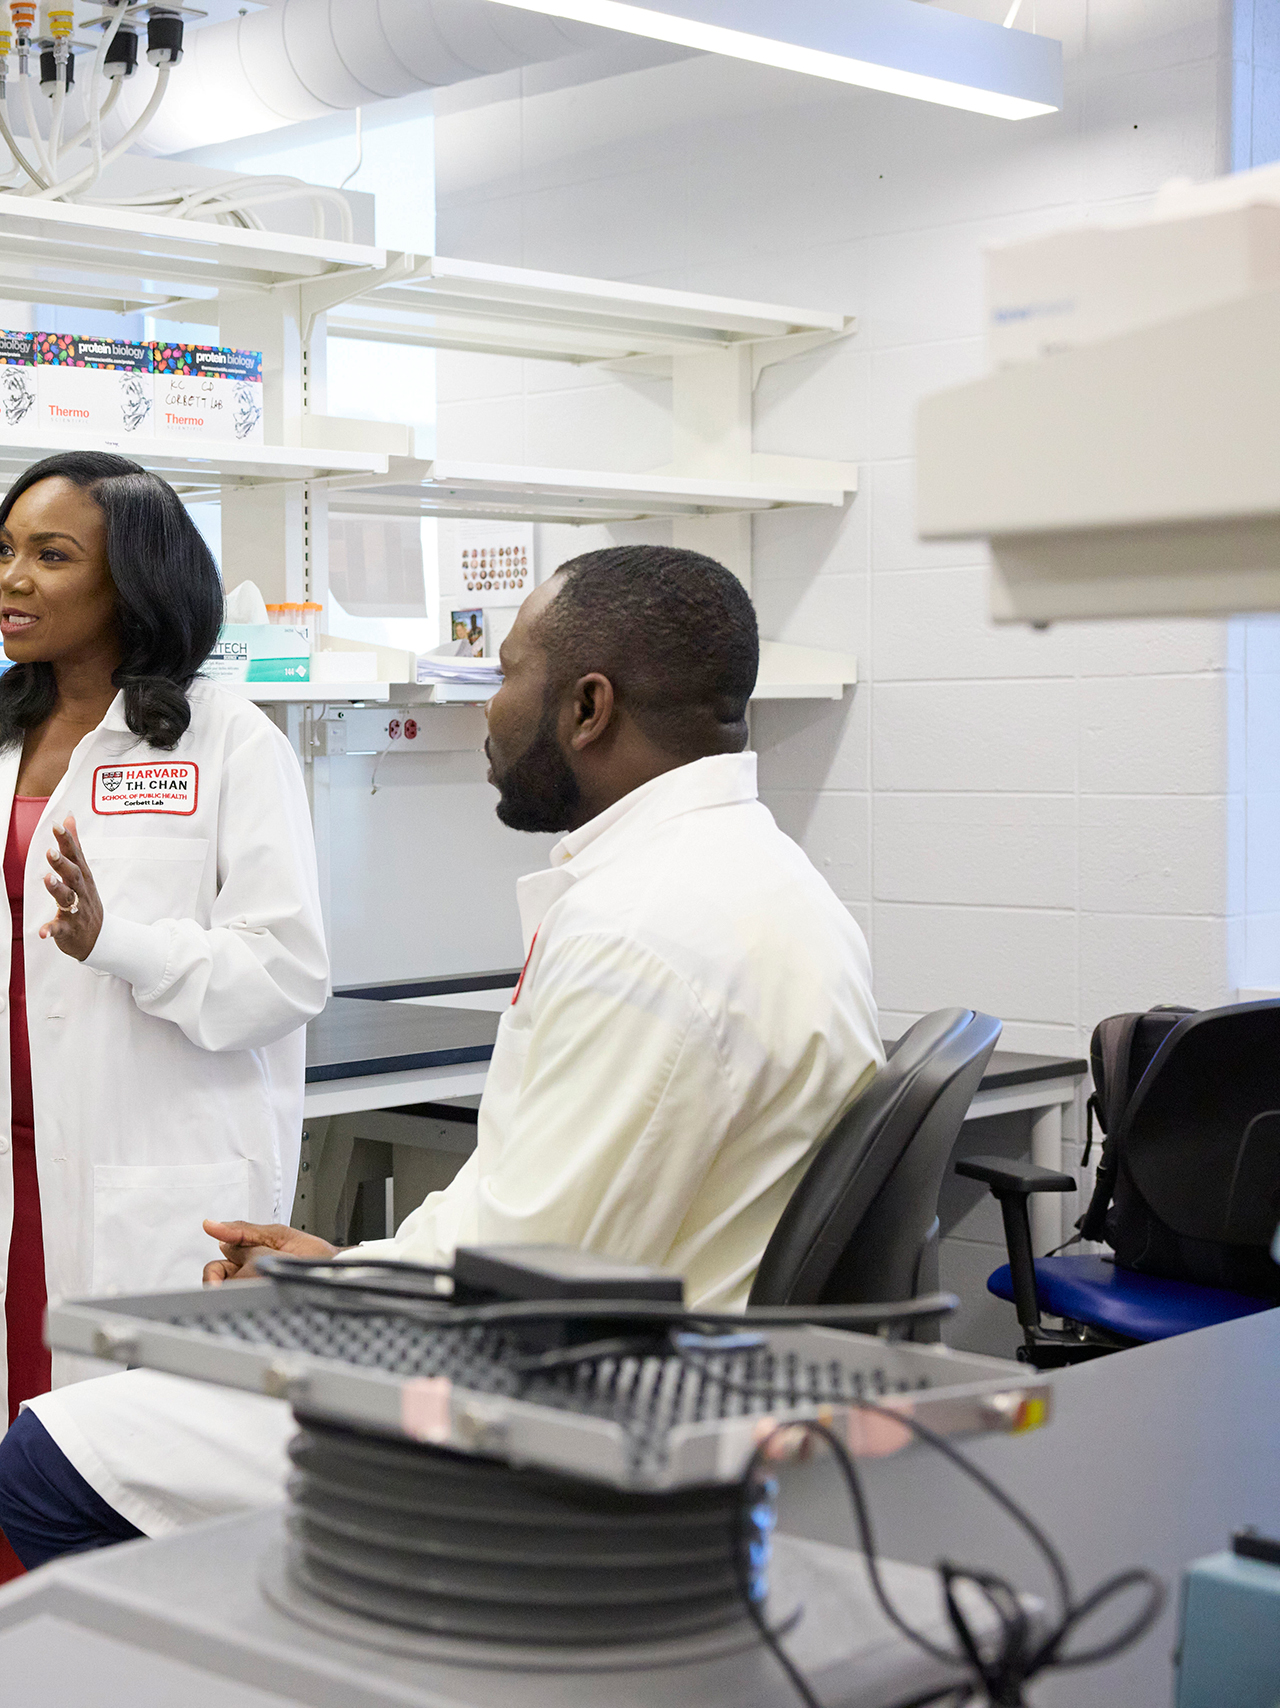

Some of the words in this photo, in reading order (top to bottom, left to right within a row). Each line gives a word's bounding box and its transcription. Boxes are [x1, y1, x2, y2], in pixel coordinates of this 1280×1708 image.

[78, 343, 112, 354] protein
[112, 344, 145, 359] biology
[196, 352, 226, 364] protein
[227, 353, 255, 369] biology
[170, 380, 185, 390] KC
[165, 394, 207, 408] CORBETT
[210, 397, 224, 410] LAB
[48, 405, 90, 418] Thermo
[165, 413, 204, 426] Thermo
[216, 643, 247, 654] TECH
[285, 668, 294, 676] 144
[126, 768, 188, 780] HARVARD
[126, 781, 146, 790] T.H.
[149, 780, 188, 790] CHAN
